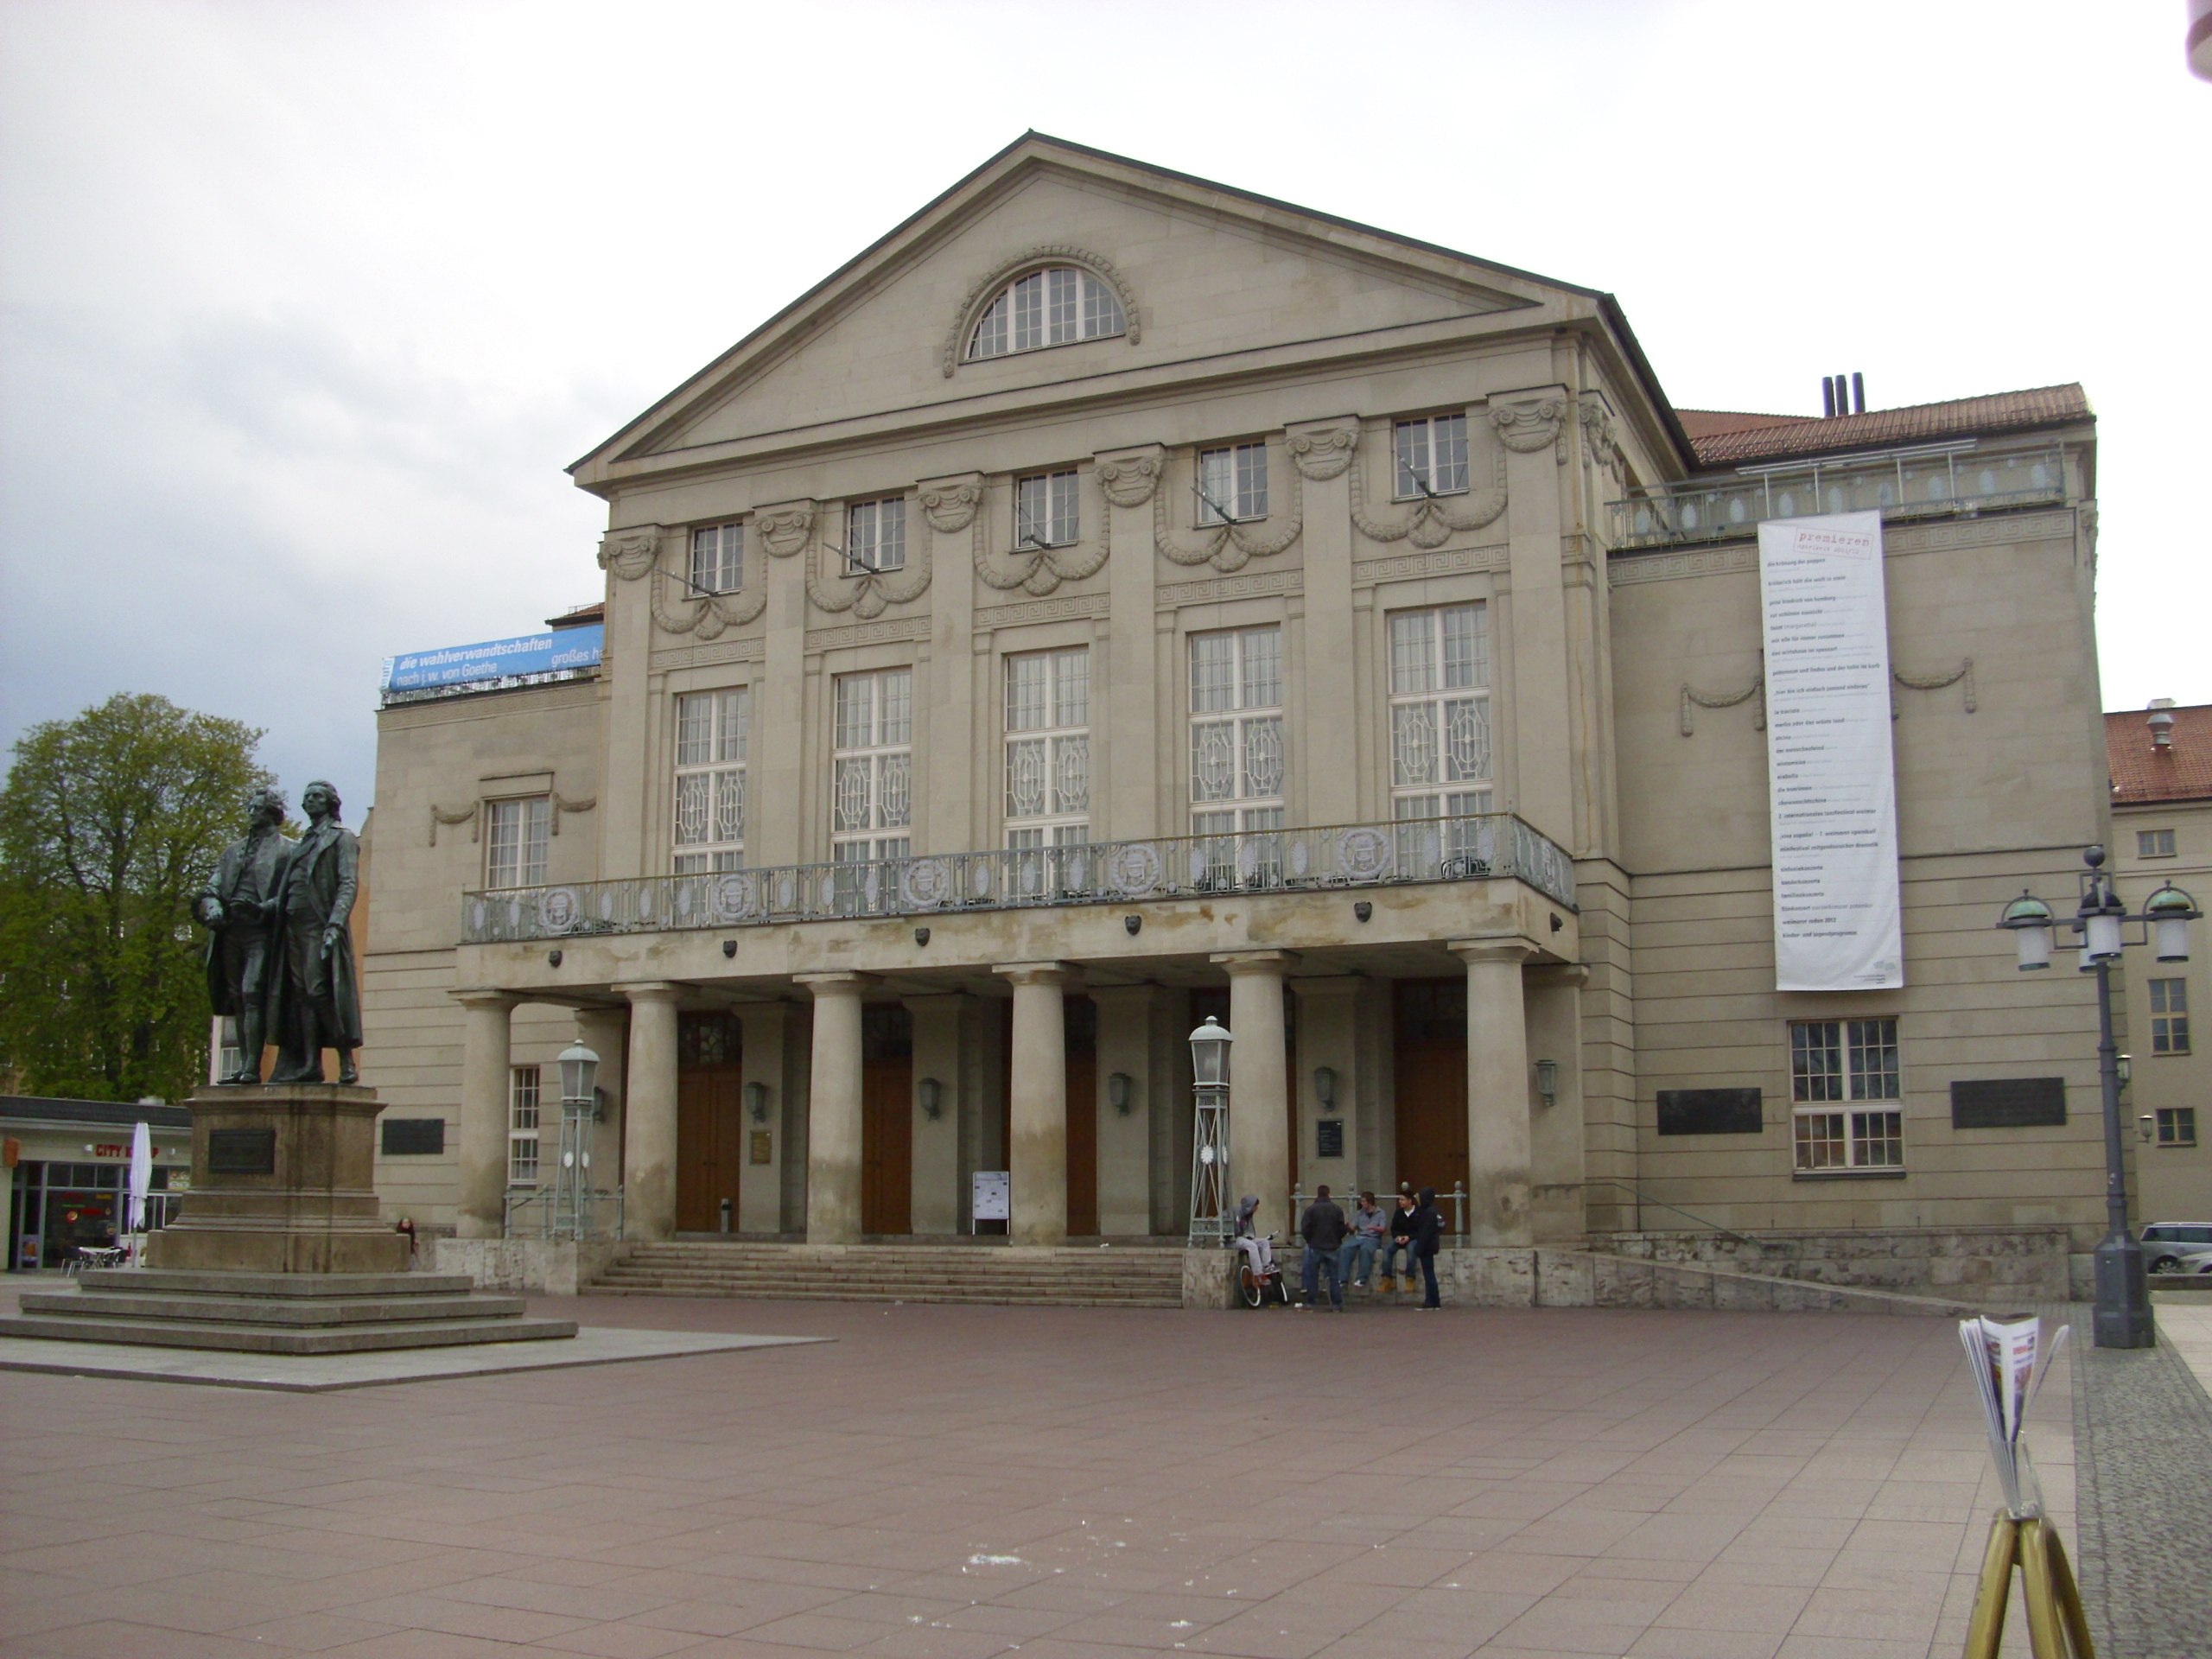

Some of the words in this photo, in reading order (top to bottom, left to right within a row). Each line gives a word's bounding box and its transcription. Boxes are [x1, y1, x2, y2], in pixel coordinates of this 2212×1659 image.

[1799, 532, 1870, 547] premieren
[400, 657, 418, 670] die
[420, 638, 552, 666] wahlverwandtschaften
[551, 649, 588, 667] großes
[397, 671, 420, 686] nach
[442, 668, 460, 679] von
[462, 661, 497, 677] Goethe
[96, 1144, 122, 1157] CITY
